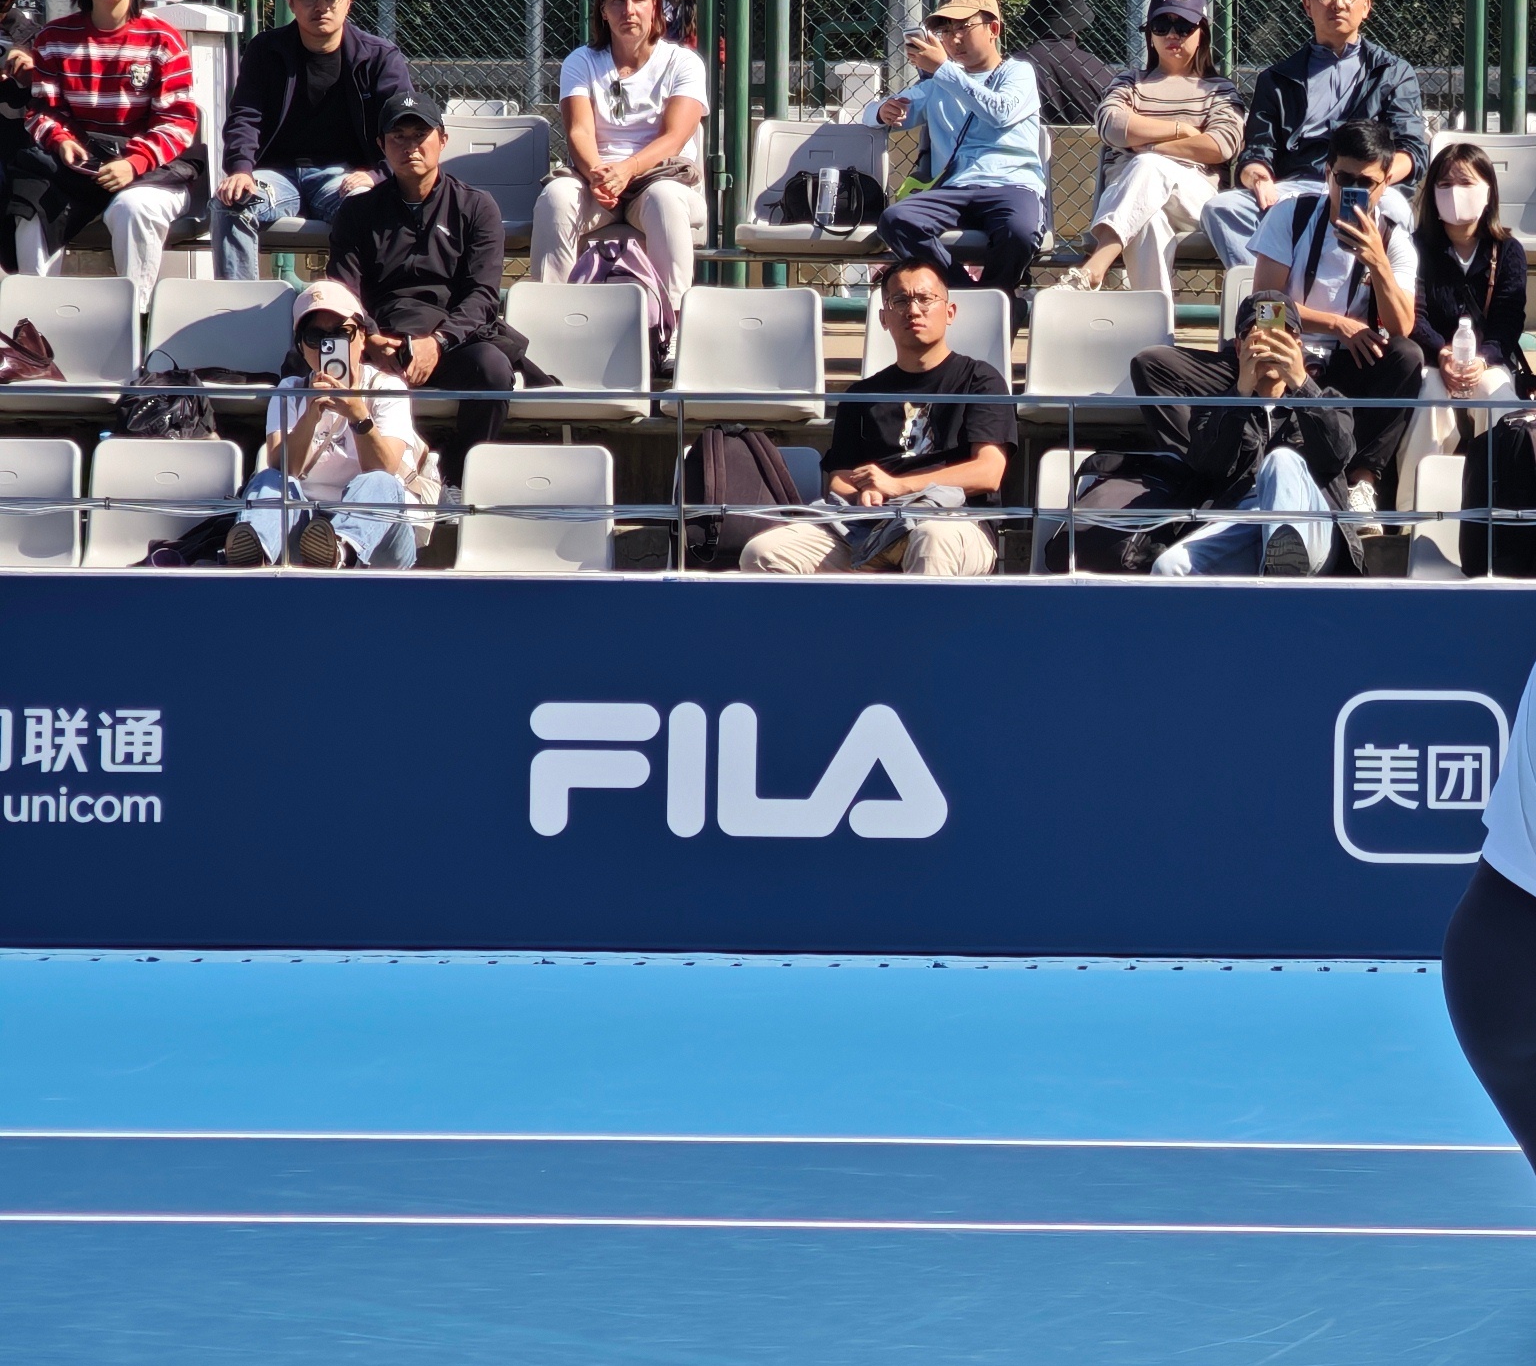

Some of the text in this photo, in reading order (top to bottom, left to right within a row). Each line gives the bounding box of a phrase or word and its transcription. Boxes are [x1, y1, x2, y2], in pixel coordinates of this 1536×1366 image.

[529, 701, 949, 839] FILA
[1352, 742, 1491, 810] 美团
[3, 786, 162, 823] unicom
